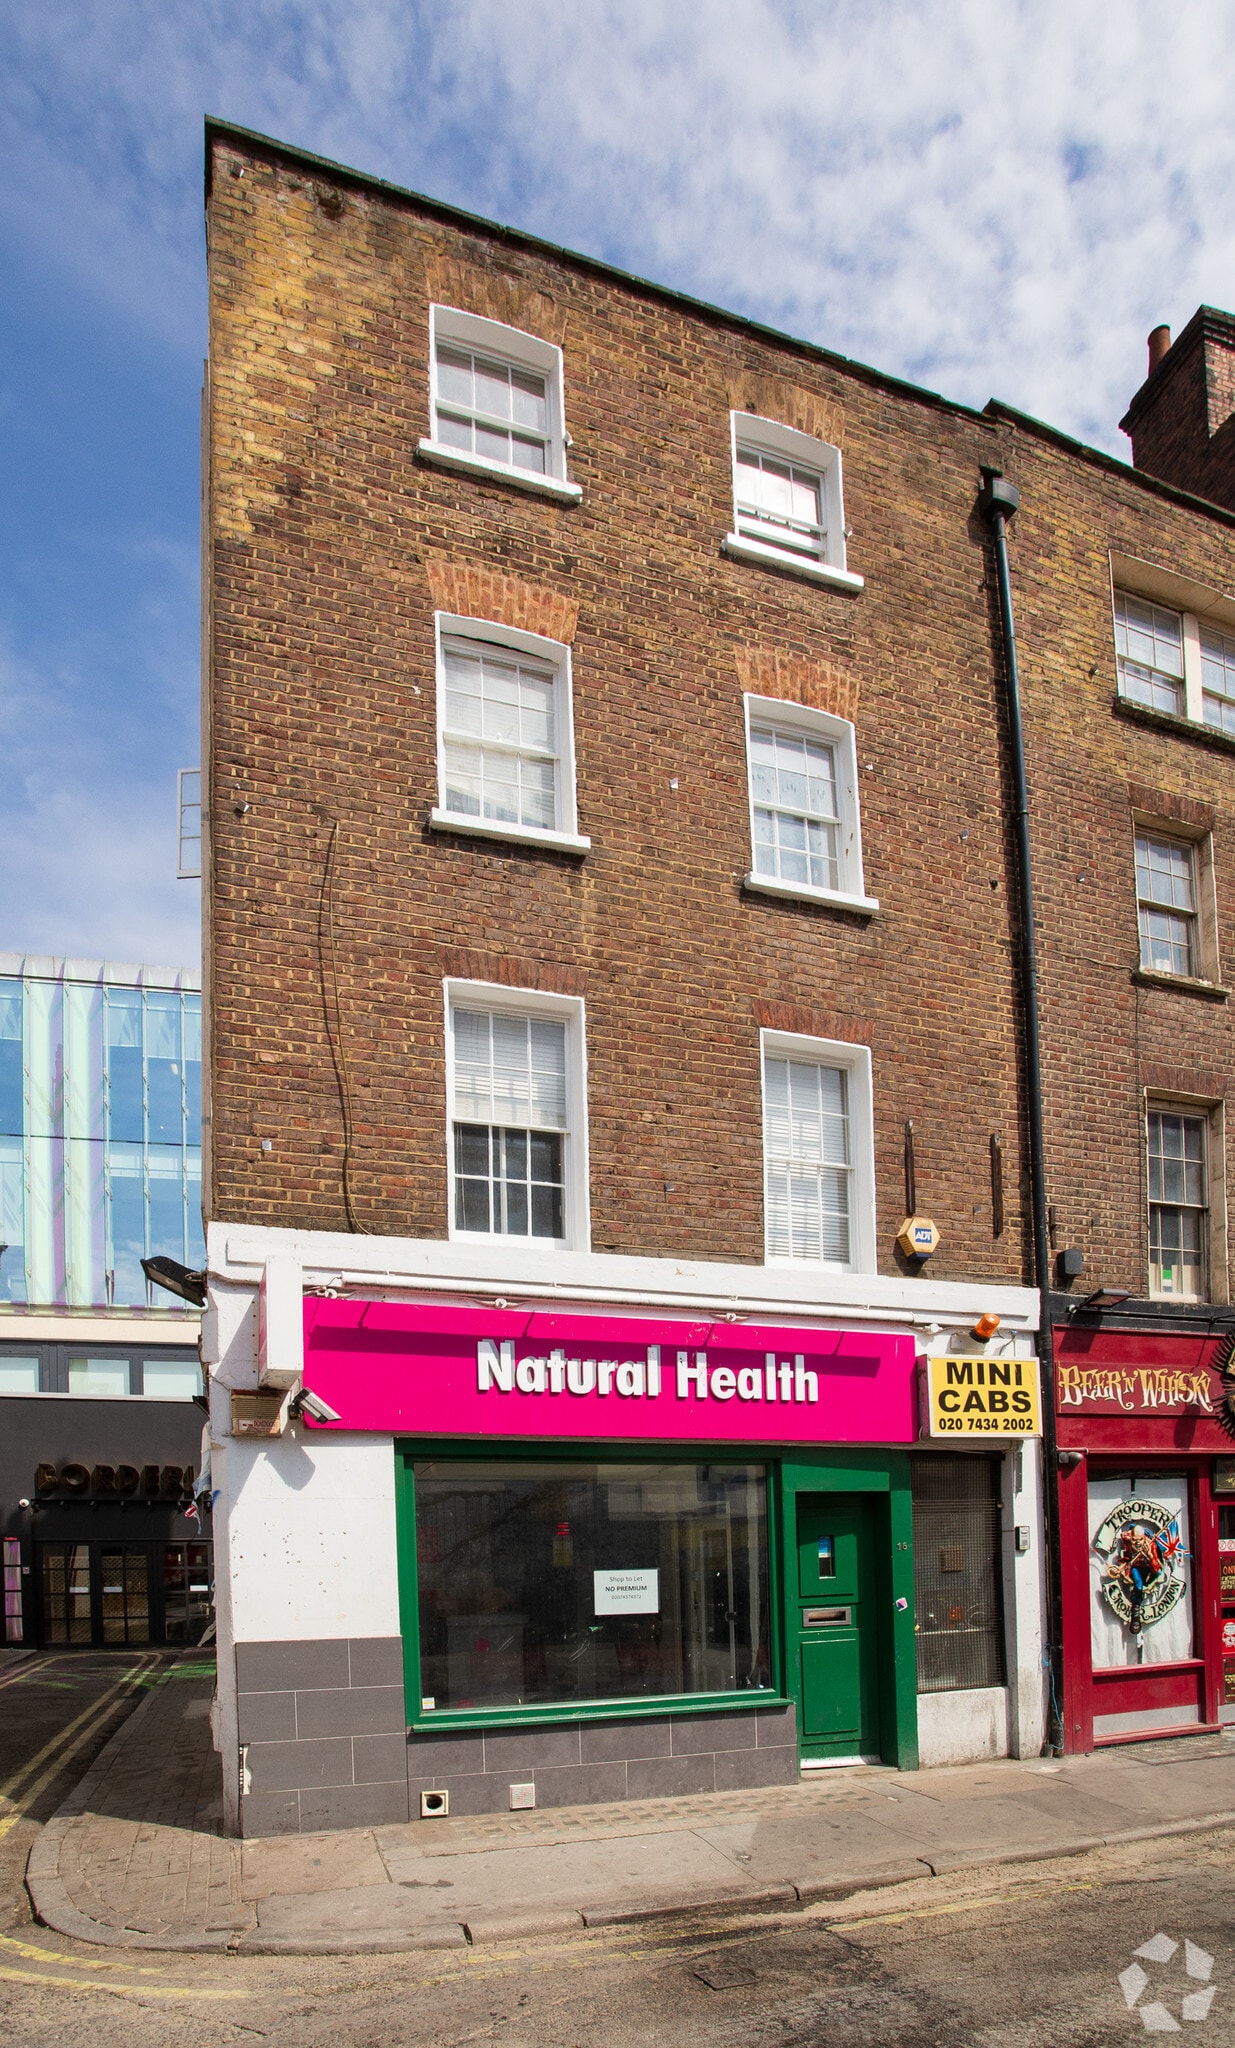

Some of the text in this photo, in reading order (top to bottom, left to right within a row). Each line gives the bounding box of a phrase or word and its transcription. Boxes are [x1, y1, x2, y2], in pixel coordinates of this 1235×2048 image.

[915, 1230, 932, 1241] ADT
[477, 1340, 819, 1402] Natural Health
[946, 1362, 1022, 1386] MINI
[938, 1389, 1032, 1413] CABS
[939, 1418, 1033, 1431] 020 7434 2002
[1105, 1501, 1170, 1531] TROOPER
[1151, 1579, 1181, 1619] LONDON
